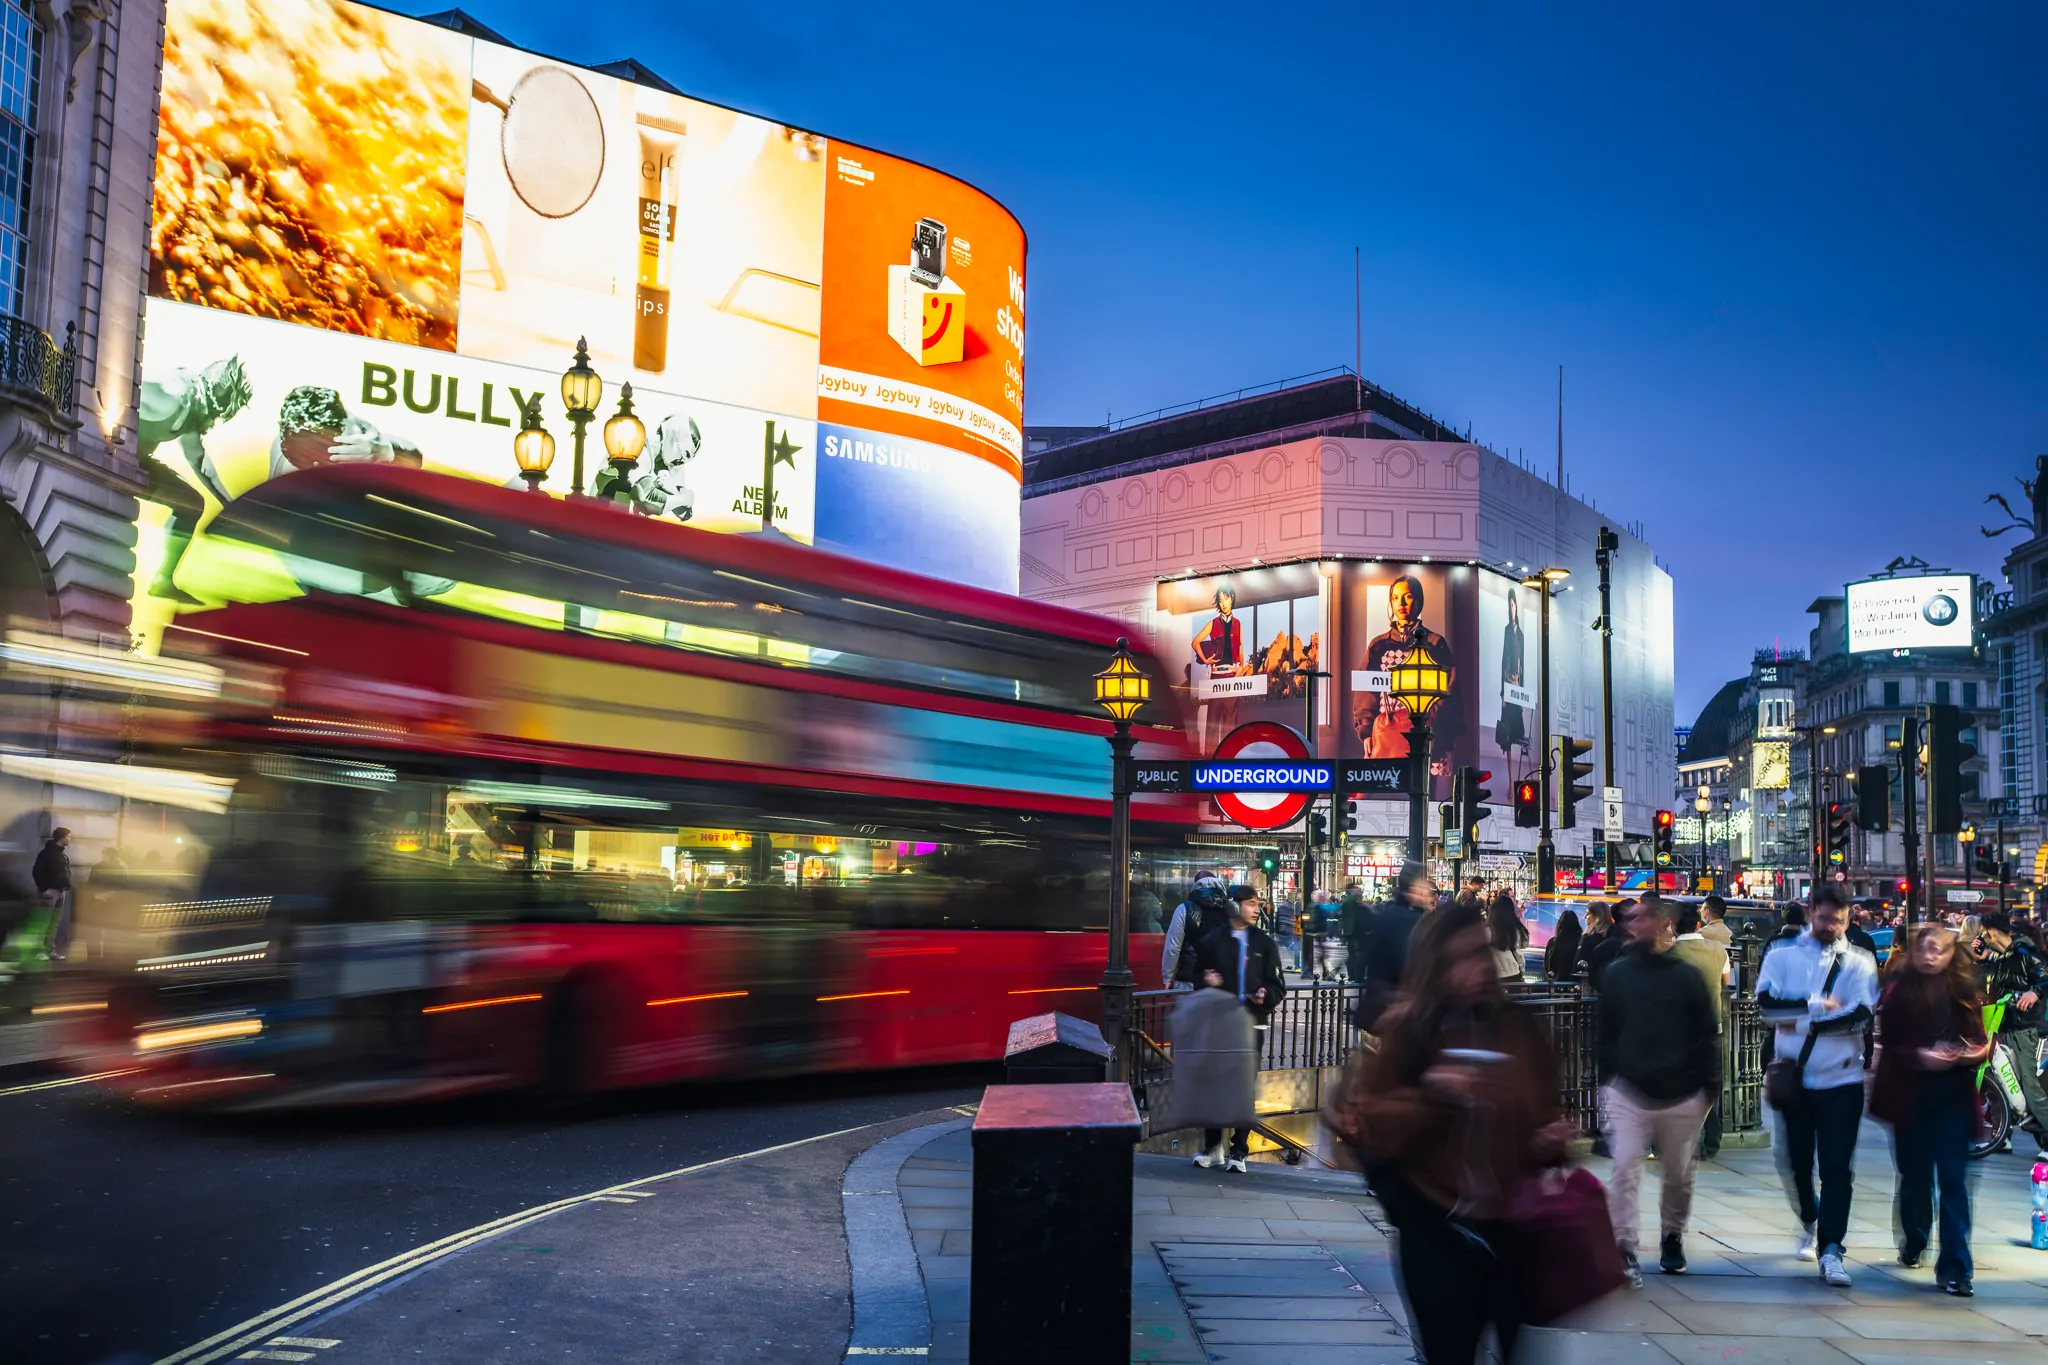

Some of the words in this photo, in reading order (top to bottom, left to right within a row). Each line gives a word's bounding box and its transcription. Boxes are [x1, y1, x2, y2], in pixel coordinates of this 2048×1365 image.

[361, 361, 545, 430] BULLY
[818, 373, 867, 396] Joybuy
[876, 385, 921, 408] Joybuy
[928, 397, 965, 420] Joybuy
[969, 410, 996, 432] Joybuy
[825, 435, 931, 474] SAMSUNG
[1137, 770, 1179, 782] PUBLIC
[1195, 768, 1329, 784] UNDERGROUND
[1347, 769, 1401, 783] SUBWAY
[700, 833, 720, 842] HOT
[722, 833, 742, 842] DOG
[1348, 856, 1405, 867] SOUVENIRS
